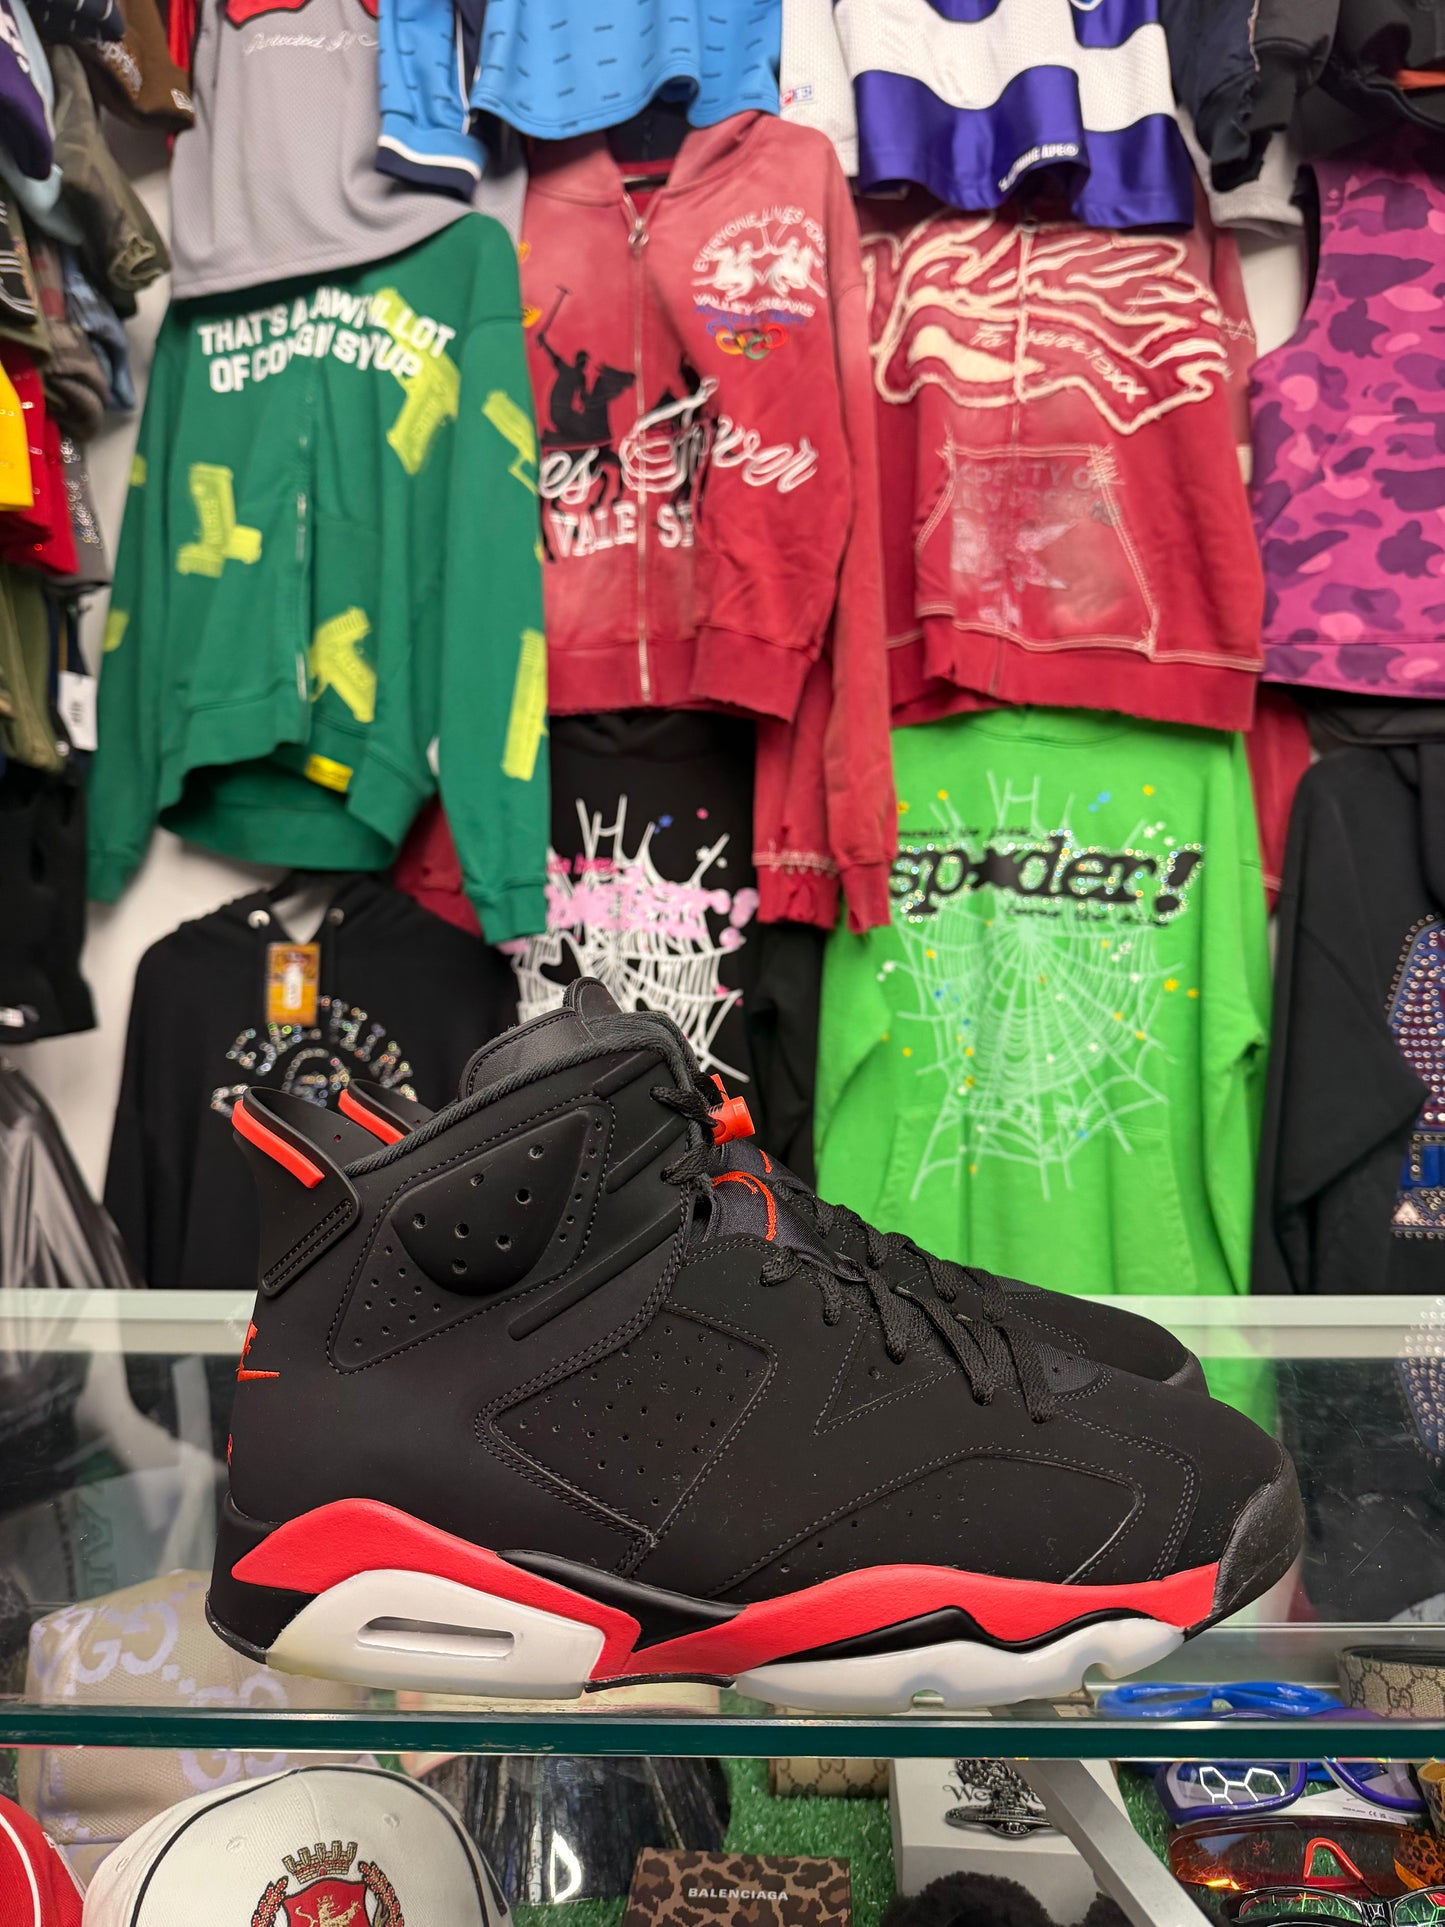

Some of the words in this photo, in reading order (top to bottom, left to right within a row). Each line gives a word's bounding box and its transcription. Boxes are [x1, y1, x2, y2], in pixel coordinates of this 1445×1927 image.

[197, 303, 289, 356] THAT'S
[290, 296, 309, 332] A
[394, 306, 457, 358] LOT
[208, 354, 251, 393] OF
[548, 500, 637, 558] VALE
[688, 1887, 789, 1901] BALENCIAGA
